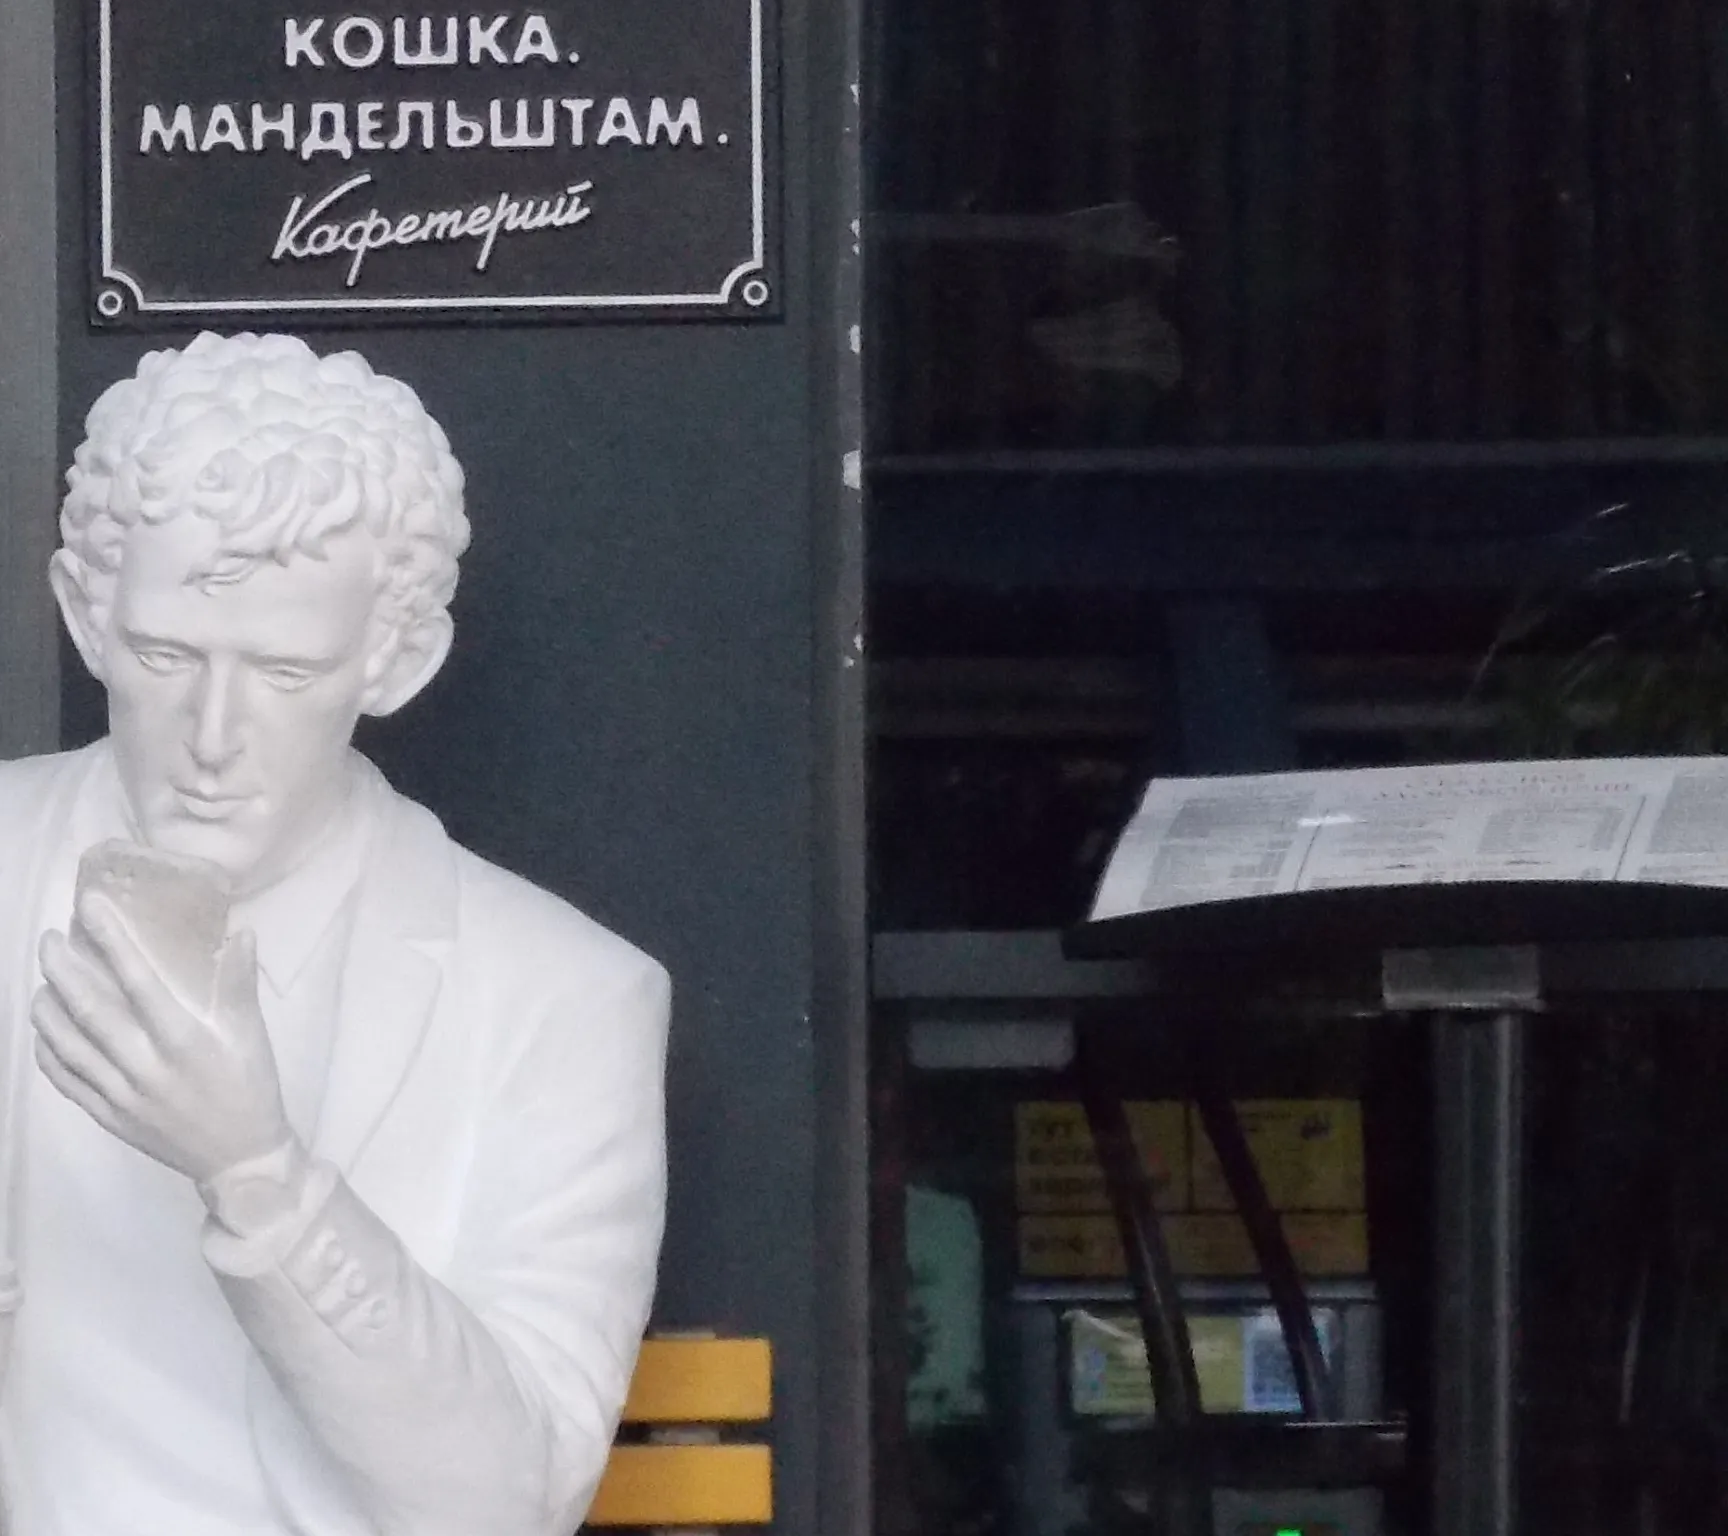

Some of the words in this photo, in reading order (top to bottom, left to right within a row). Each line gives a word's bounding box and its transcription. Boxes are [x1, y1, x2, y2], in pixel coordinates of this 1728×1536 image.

[284, 14, 580, 70] КОШКА.
[139, 96, 730, 160] МАНДЕЛЬШТАМ.
[272, 174, 594, 286] Кафетерий
